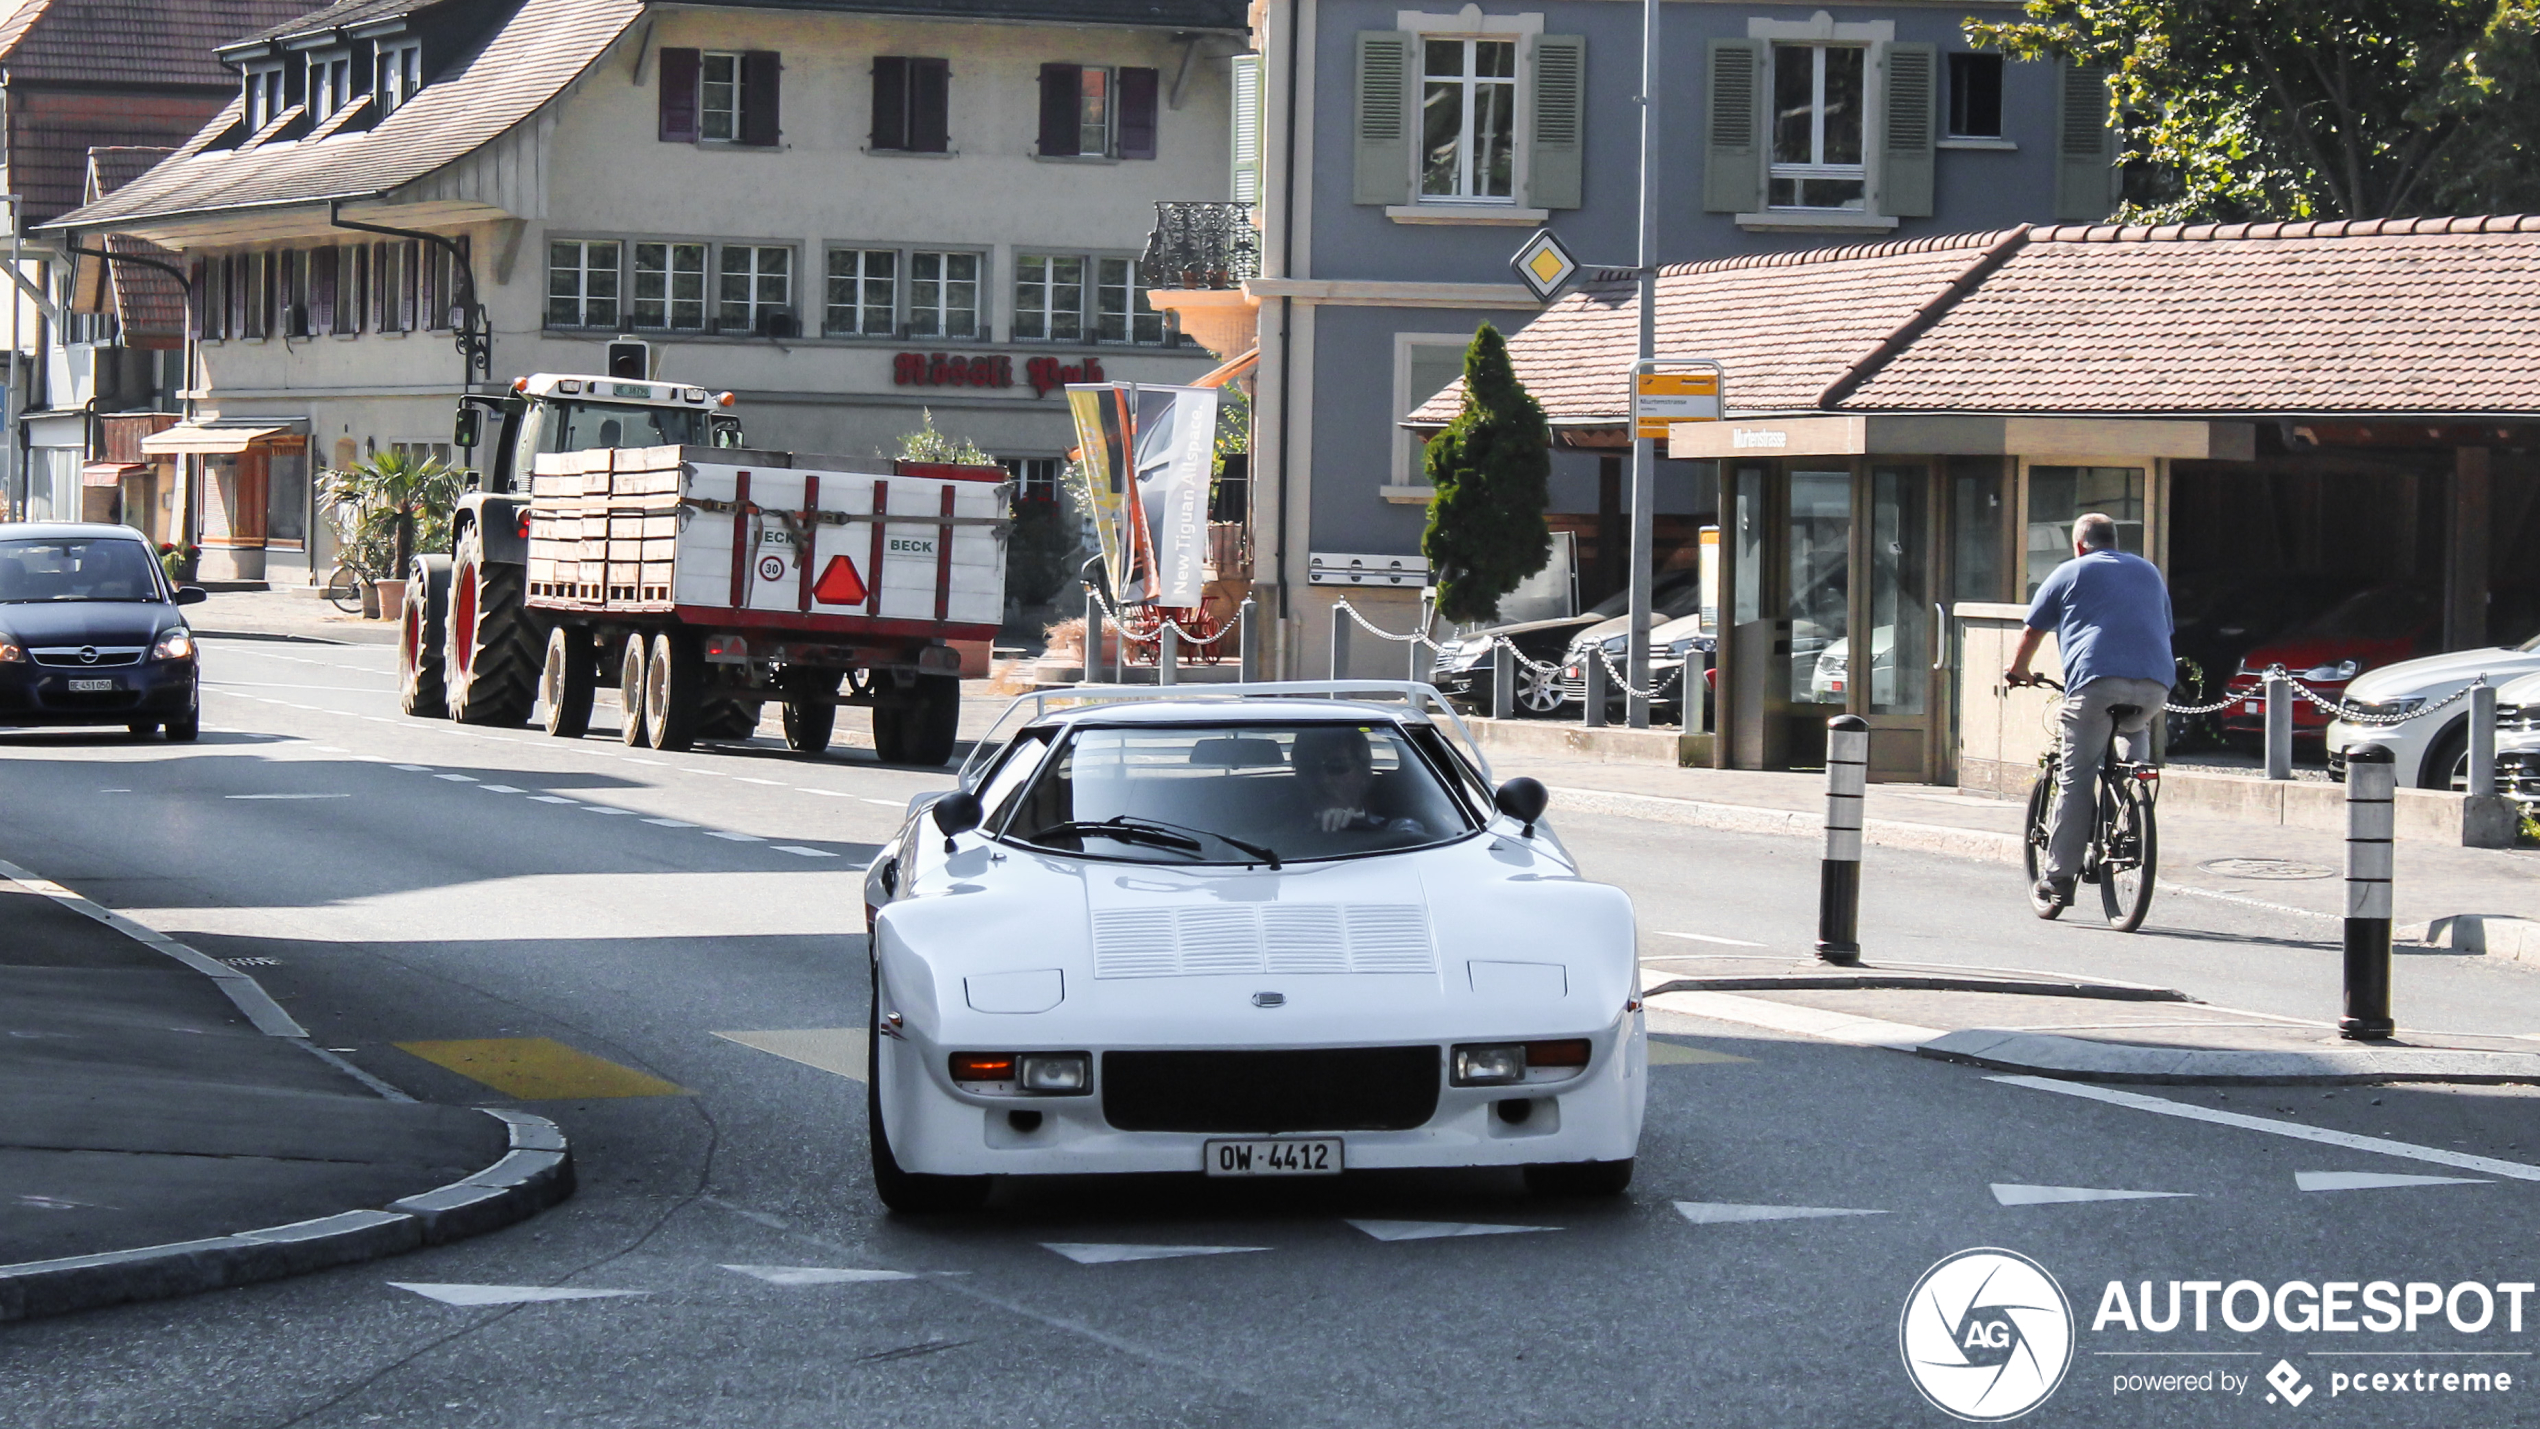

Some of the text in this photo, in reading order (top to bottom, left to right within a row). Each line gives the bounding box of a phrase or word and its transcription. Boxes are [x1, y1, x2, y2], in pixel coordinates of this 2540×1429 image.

[894, 352, 1105, 398] Rössli Pub
[1733, 428, 1786, 448] Murtenstrasse
[1173, 404, 1203, 595] New Tiguan Allspace.
[754, 530, 796, 544] ECK
[890, 539, 933, 553] BECK
[765, 563, 779, 574] 30
